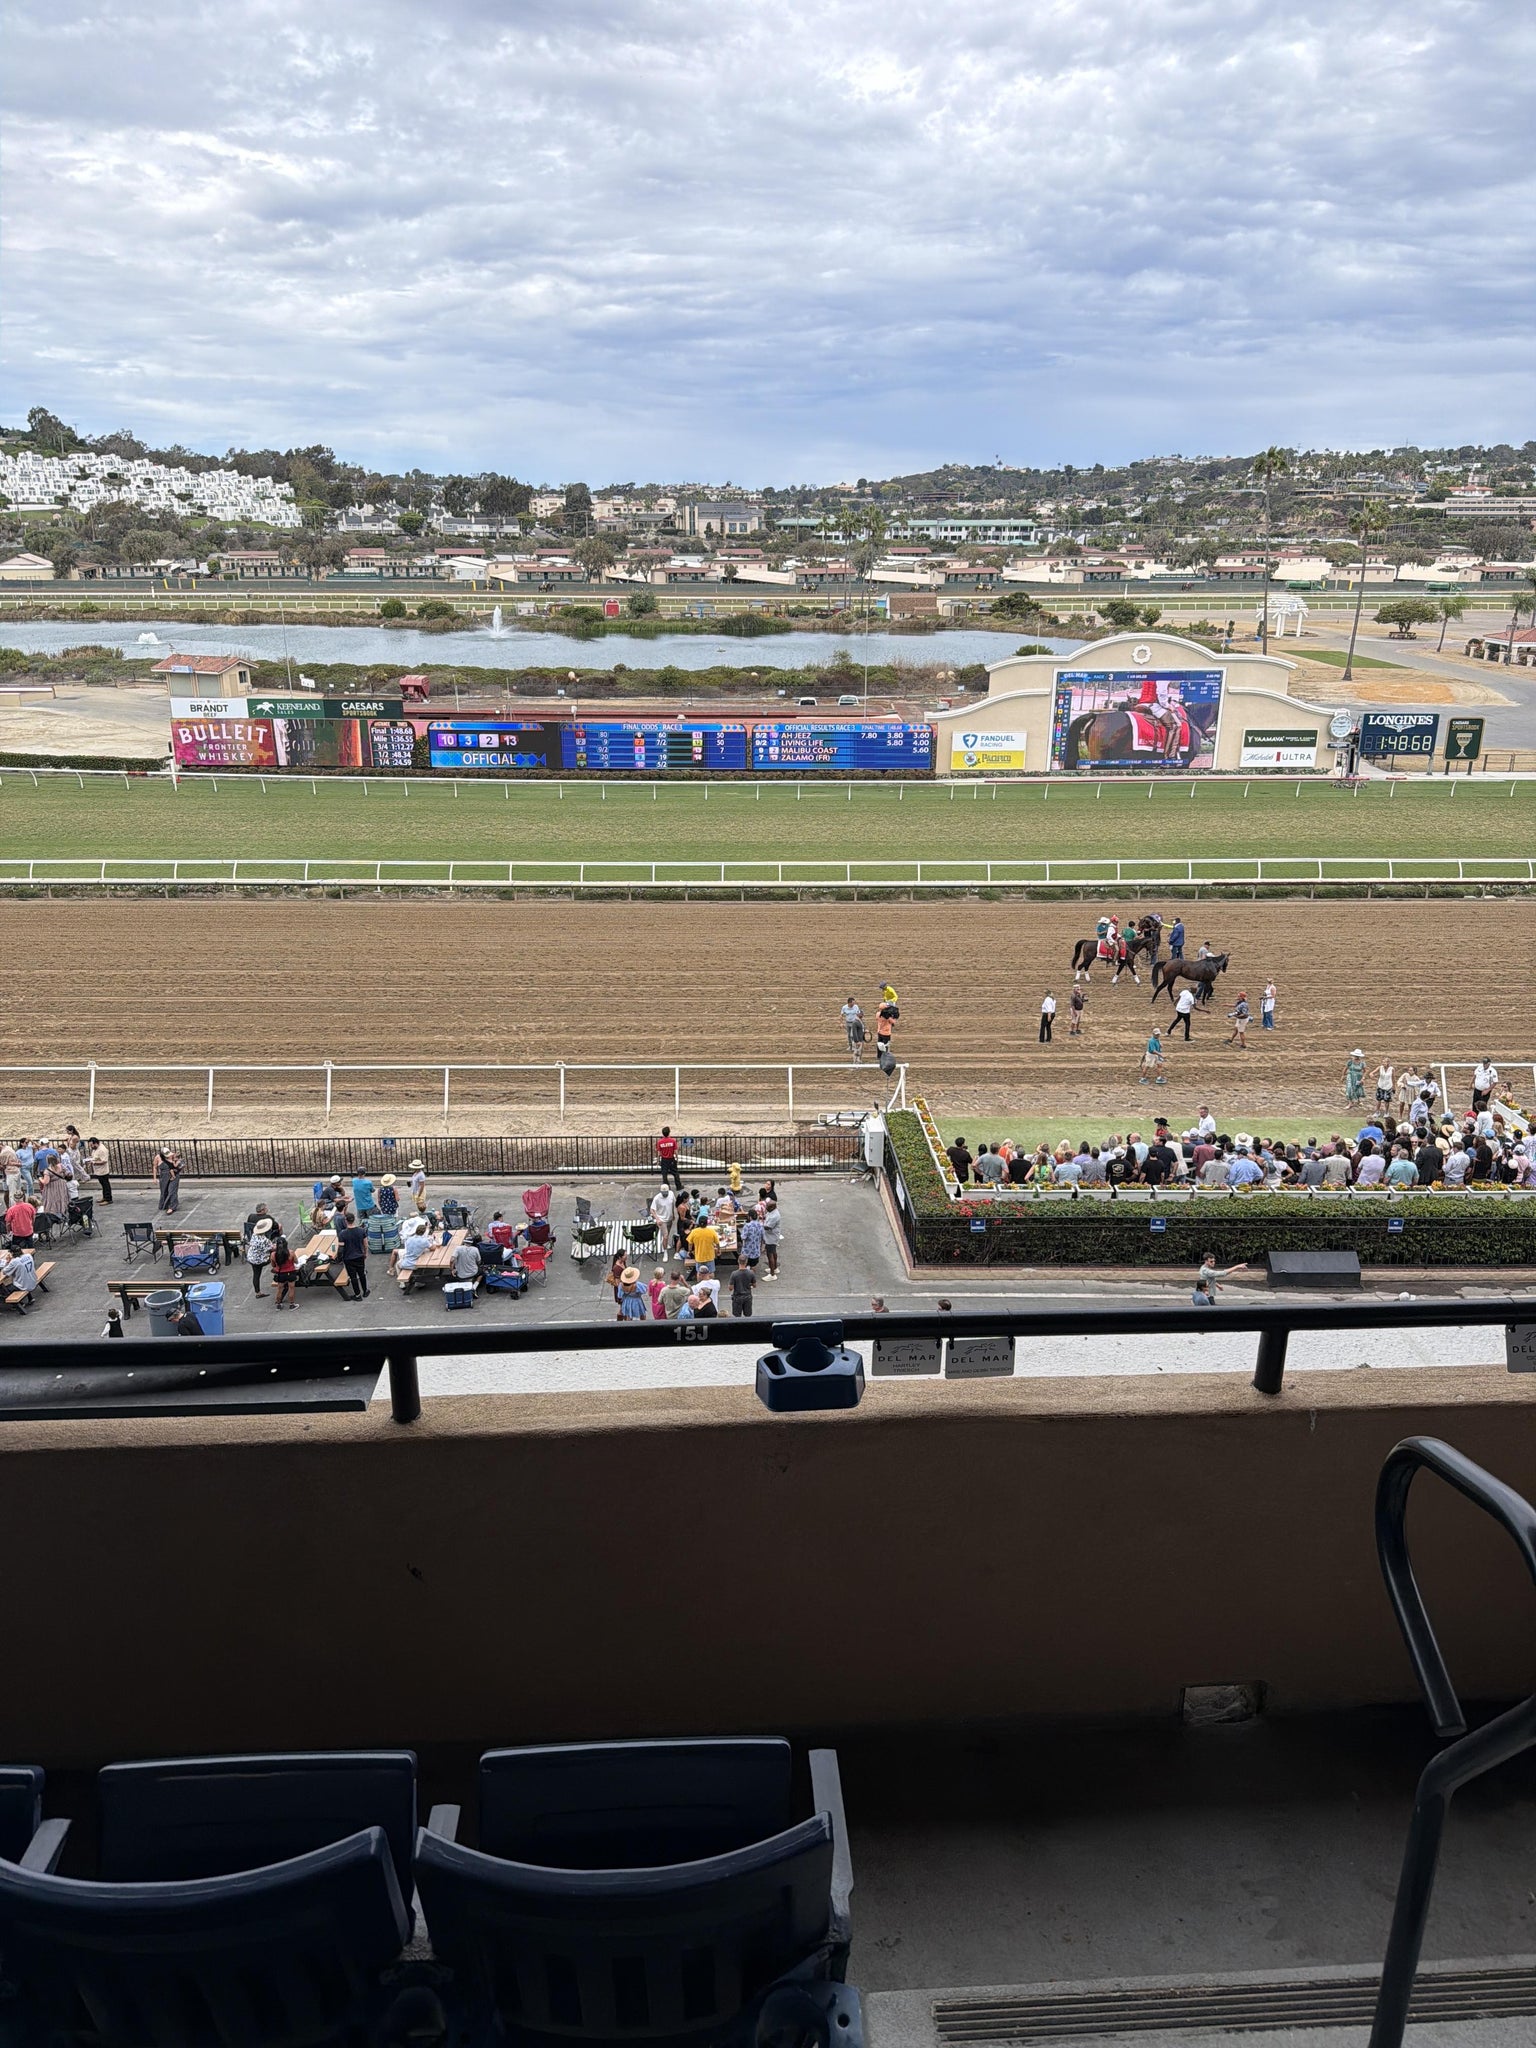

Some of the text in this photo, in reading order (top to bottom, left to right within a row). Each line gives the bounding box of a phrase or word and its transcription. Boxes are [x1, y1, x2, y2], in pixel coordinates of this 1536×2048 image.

[190, 704, 228, 712] BRANDT
[277, 703, 320, 711] KEENELAND
[341, 702, 384, 711] CAESARS
[1368, 715, 1434, 725] LONGINES
[178, 723, 268, 744] BULLEIT
[442, 736, 517, 746] 10 3 2 13
[1380, 735, 1432, 751] 1:48.68
[462, 753, 517, 765] OFFICIAL
[1282, 753, 1312, 761] ULTRA
[24, 1261, 33, 1273] 17
[673, 1325, 709, 1341] 15J
[1512, 1345, 1535, 1353] DEL
[982, 1354, 1009, 1362] MAR
